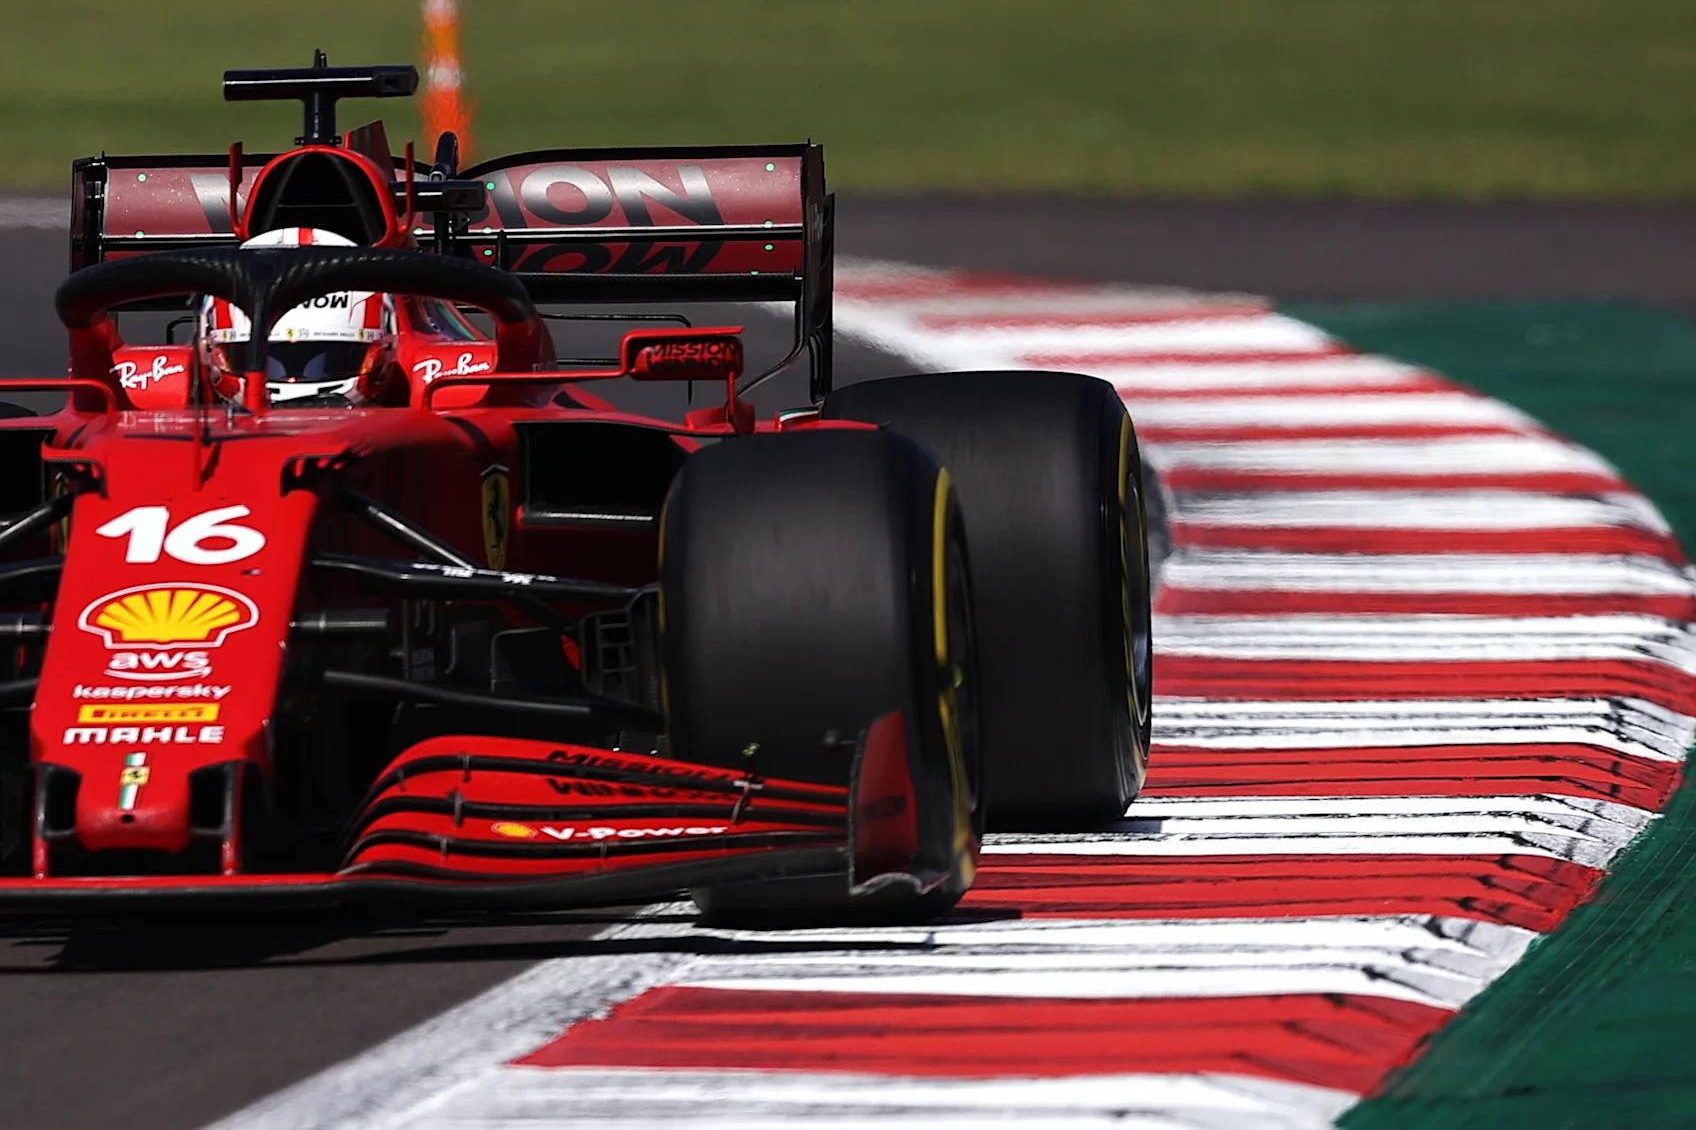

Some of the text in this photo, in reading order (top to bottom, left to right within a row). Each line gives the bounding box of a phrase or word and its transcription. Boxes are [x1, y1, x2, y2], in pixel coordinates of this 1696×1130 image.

[109, 355, 185, 390] Ray-Ban
[96, 505, 266, 565] 16
[107, 651, 211, 672] aws
[63, 726, 225, 745] MAHLE
[540, 826, 729, 840] V-Power
